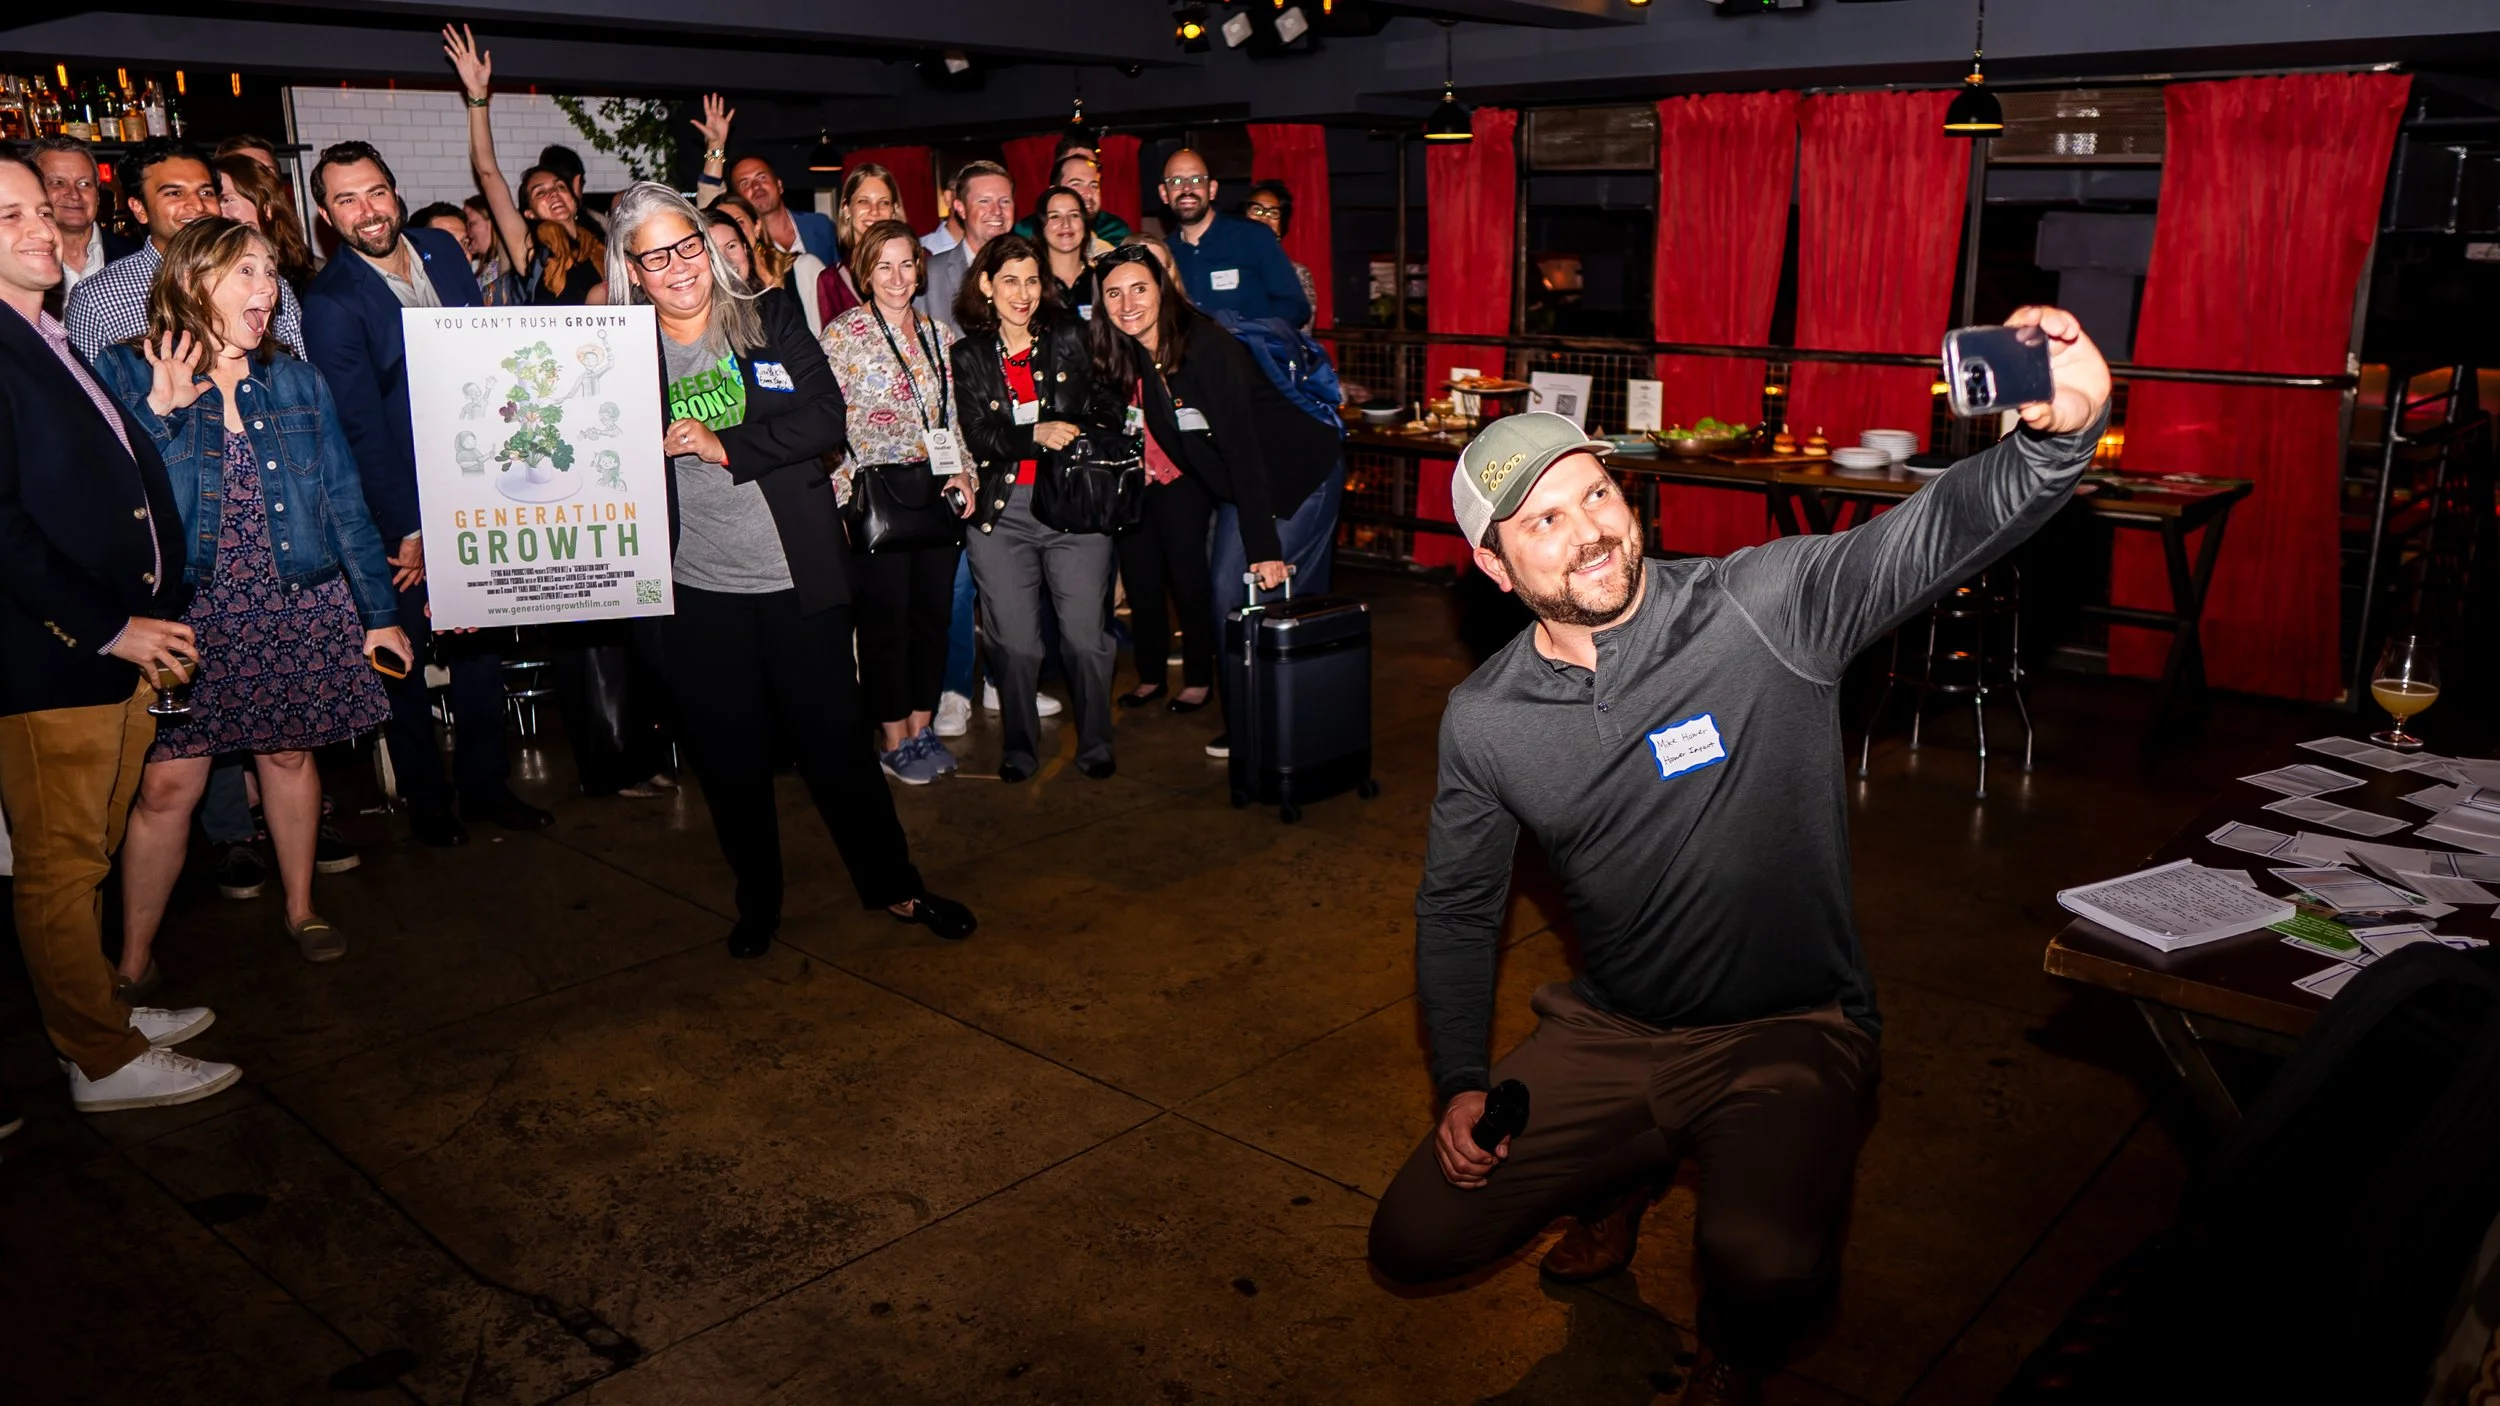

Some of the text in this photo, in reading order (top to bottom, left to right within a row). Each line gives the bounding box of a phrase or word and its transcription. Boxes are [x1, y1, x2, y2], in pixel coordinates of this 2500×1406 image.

[435, 316, 627, 329] YOU CAN'T RUSH GROWTH
[670, 368, 723, 402] REEN
[671, 377, 738, 423] RONX
[1480, 460, 1497, 484] DO
[455, 502, 637, 529] GENERATION
[457, 523, 639, 565] GROWTH
[488, 599, 620, 615] www.generationgrowthfilm.com
[1657, 738, 1677, 749] Mike
